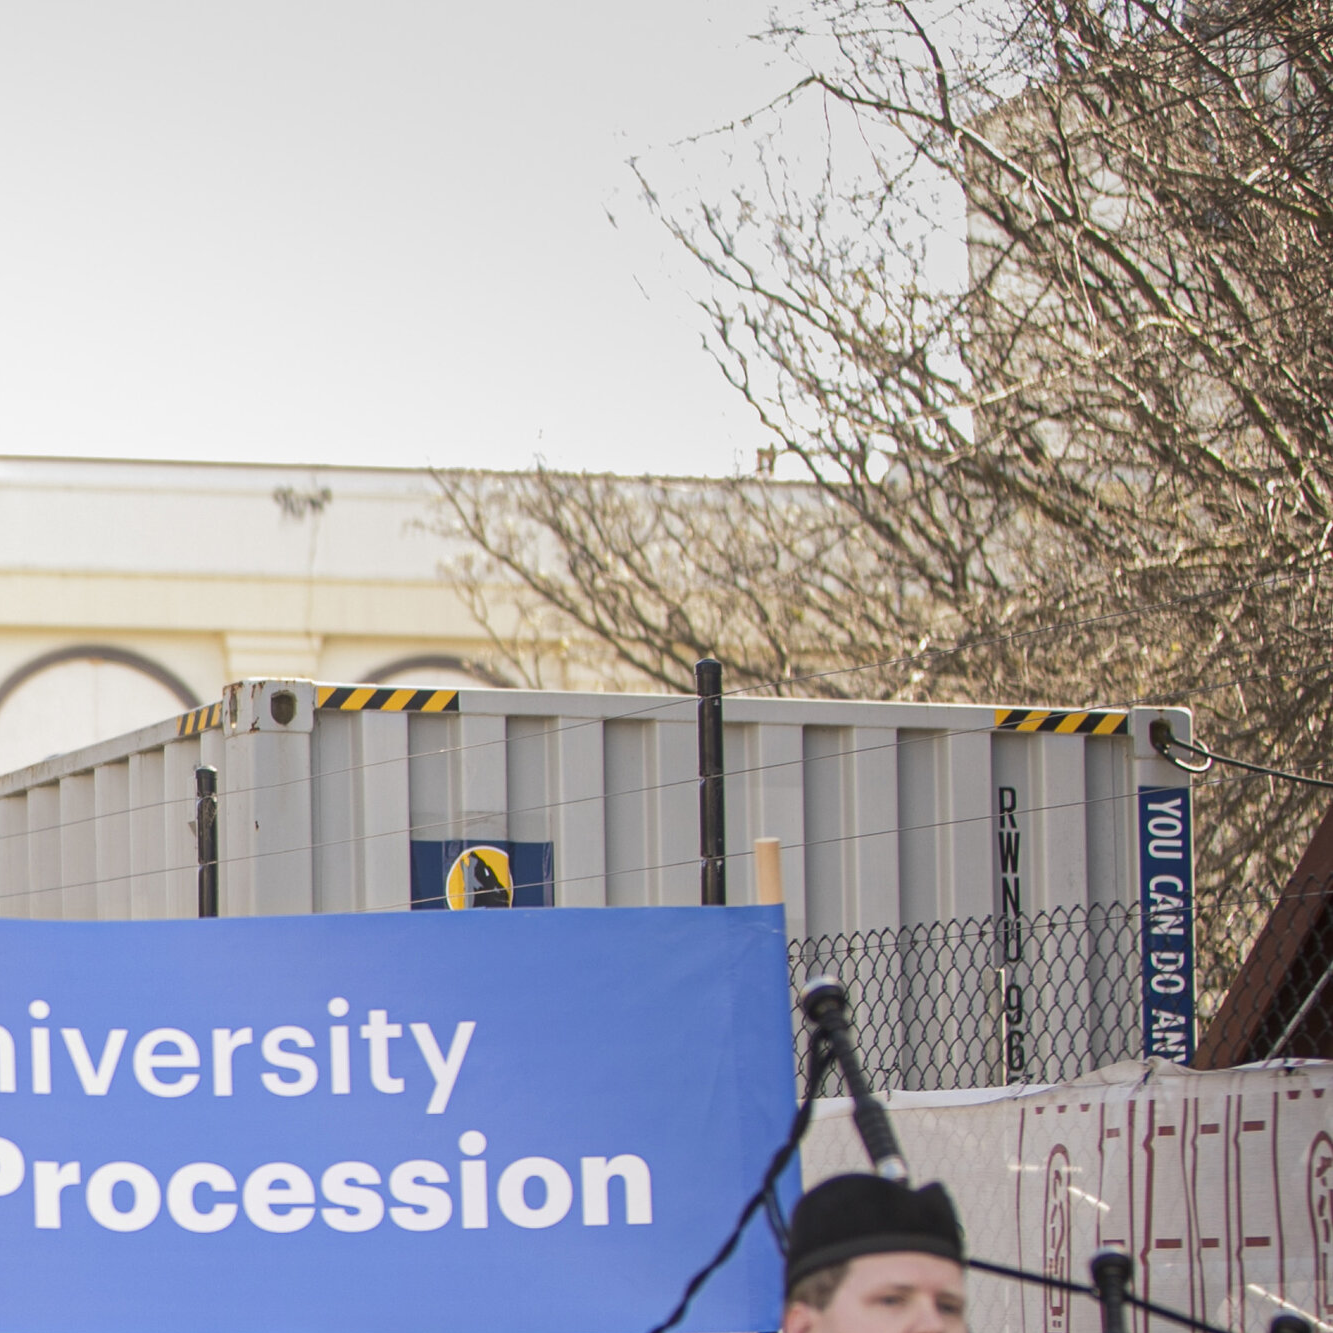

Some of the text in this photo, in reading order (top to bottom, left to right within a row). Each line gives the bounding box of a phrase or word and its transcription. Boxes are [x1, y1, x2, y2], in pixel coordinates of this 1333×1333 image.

[1147, 797, 1184, 861] YOU
[1149, 874, 1185, 935] CAN
[1150, 951, 1186, 995] DO
[1004, 984, 1026, 1084] 96
